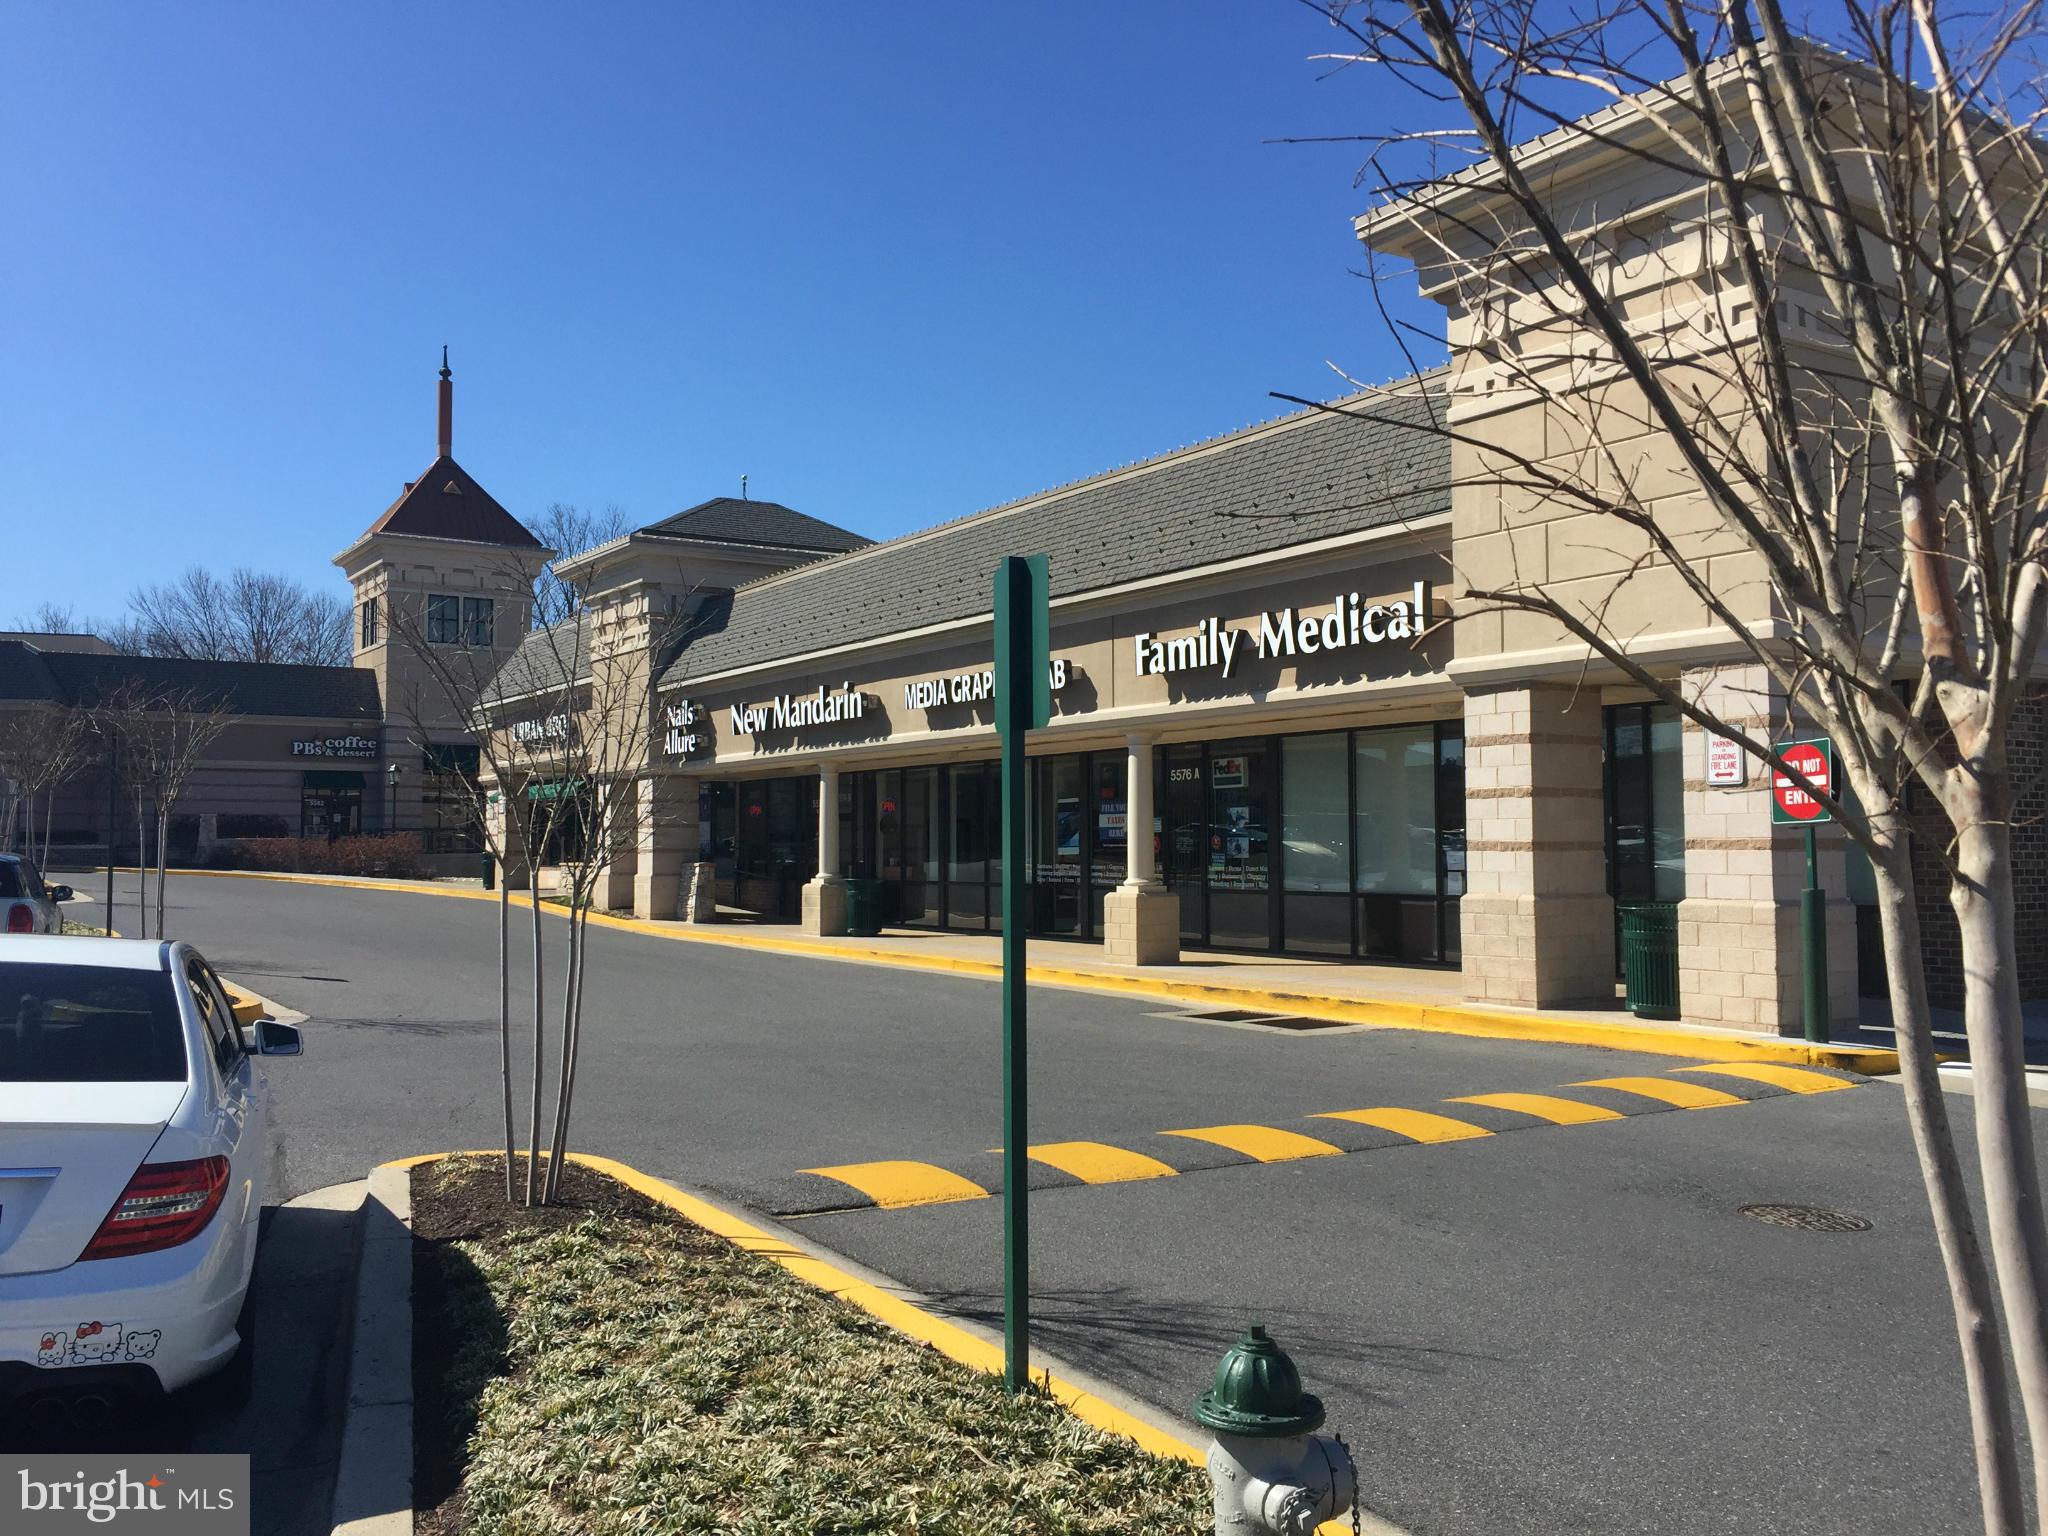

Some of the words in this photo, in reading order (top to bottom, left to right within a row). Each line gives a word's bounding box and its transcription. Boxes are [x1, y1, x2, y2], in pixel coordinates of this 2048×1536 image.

[1134, 616, 1239, 678] Family
[1258, 580, 1425, 659] Medical
[904, 678, 948, 710] MEDIA
[951, 670, 996, 703] GRAP
[667, 699, 694, 727] Nails
[730, 702, 769, 736] New
[773, 680, 863, 730] Mandarin
[512, 719, 544, 742] URBAN
[325, 736, 377, 748] coffee
[662, 728, 696, 755] Allure
[325, 748, 336, 757] &
[337, 748, 376, 757] dessert
[1711, 752, 1737, 761] STANDING
[1213, 760, 1241, 775] FedEx
[1711, 761, 1722, 770] FIRE
[1724, 760, 1737, 769] LANE
[1802, 757, 1821, 773] NOT
[1170, 768, 1192, 781] 5576
[1194, 767, 1200, 779] A
